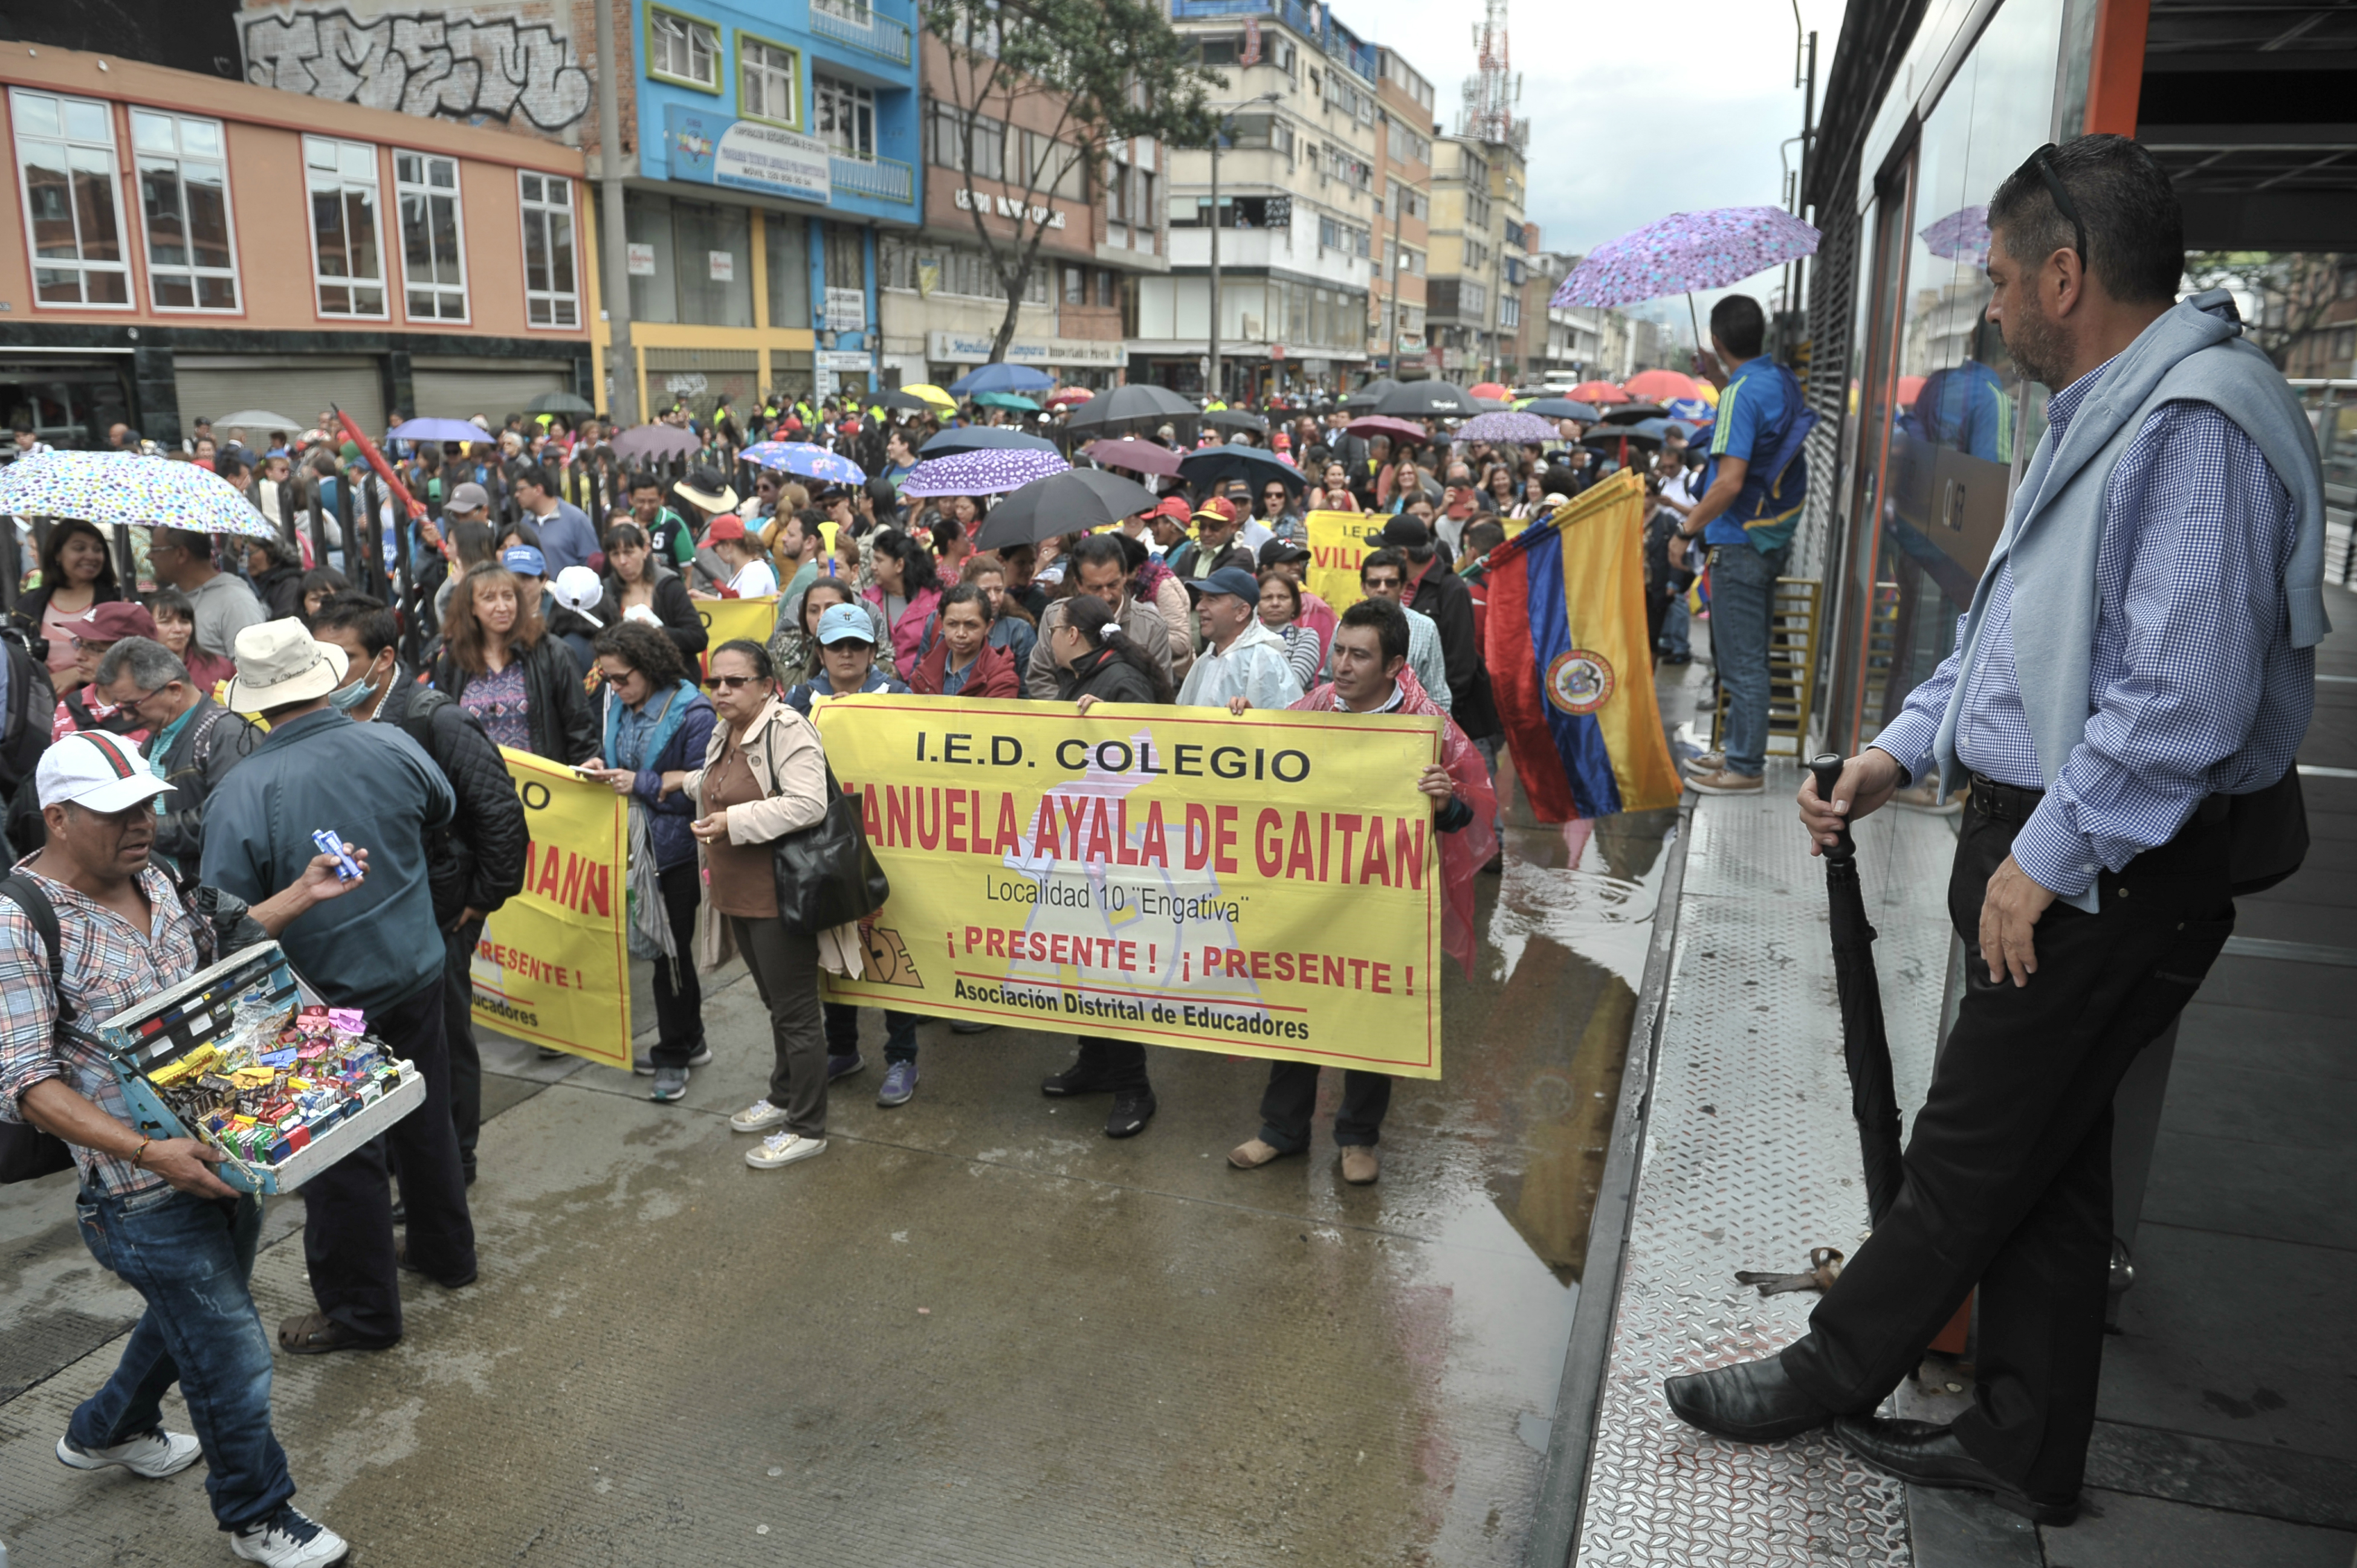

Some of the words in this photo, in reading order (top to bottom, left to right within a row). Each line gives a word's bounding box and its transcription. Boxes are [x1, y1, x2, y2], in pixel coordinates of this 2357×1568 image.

[916, 731, 1035, 767] I.E.D.
[1056, 739, 1311, 783] COLEGIO
[843, 782, 1021, 857] ANUELA
[1033, 795, 1169, 869] AYALA
[1184, 802, 1238, 874] DE
[1255, 807, 1425, 890] GAITAN
[526, 840, 610, 917] ANN
[987, 874, 1090, 909] Localidad
[1100, 884, 1125, 911] 10
[965, 926, 1136, 972] PRESENTE
[1203, 946, 1392, 995] PRESENTE
[954, 978, 1058, 1011] Asociación
[1064, 993, 1145, 1021] Distrital
[1151, 1002, 1177, 1024] de
[1183, 1005, 1310, 1040] Educadores
